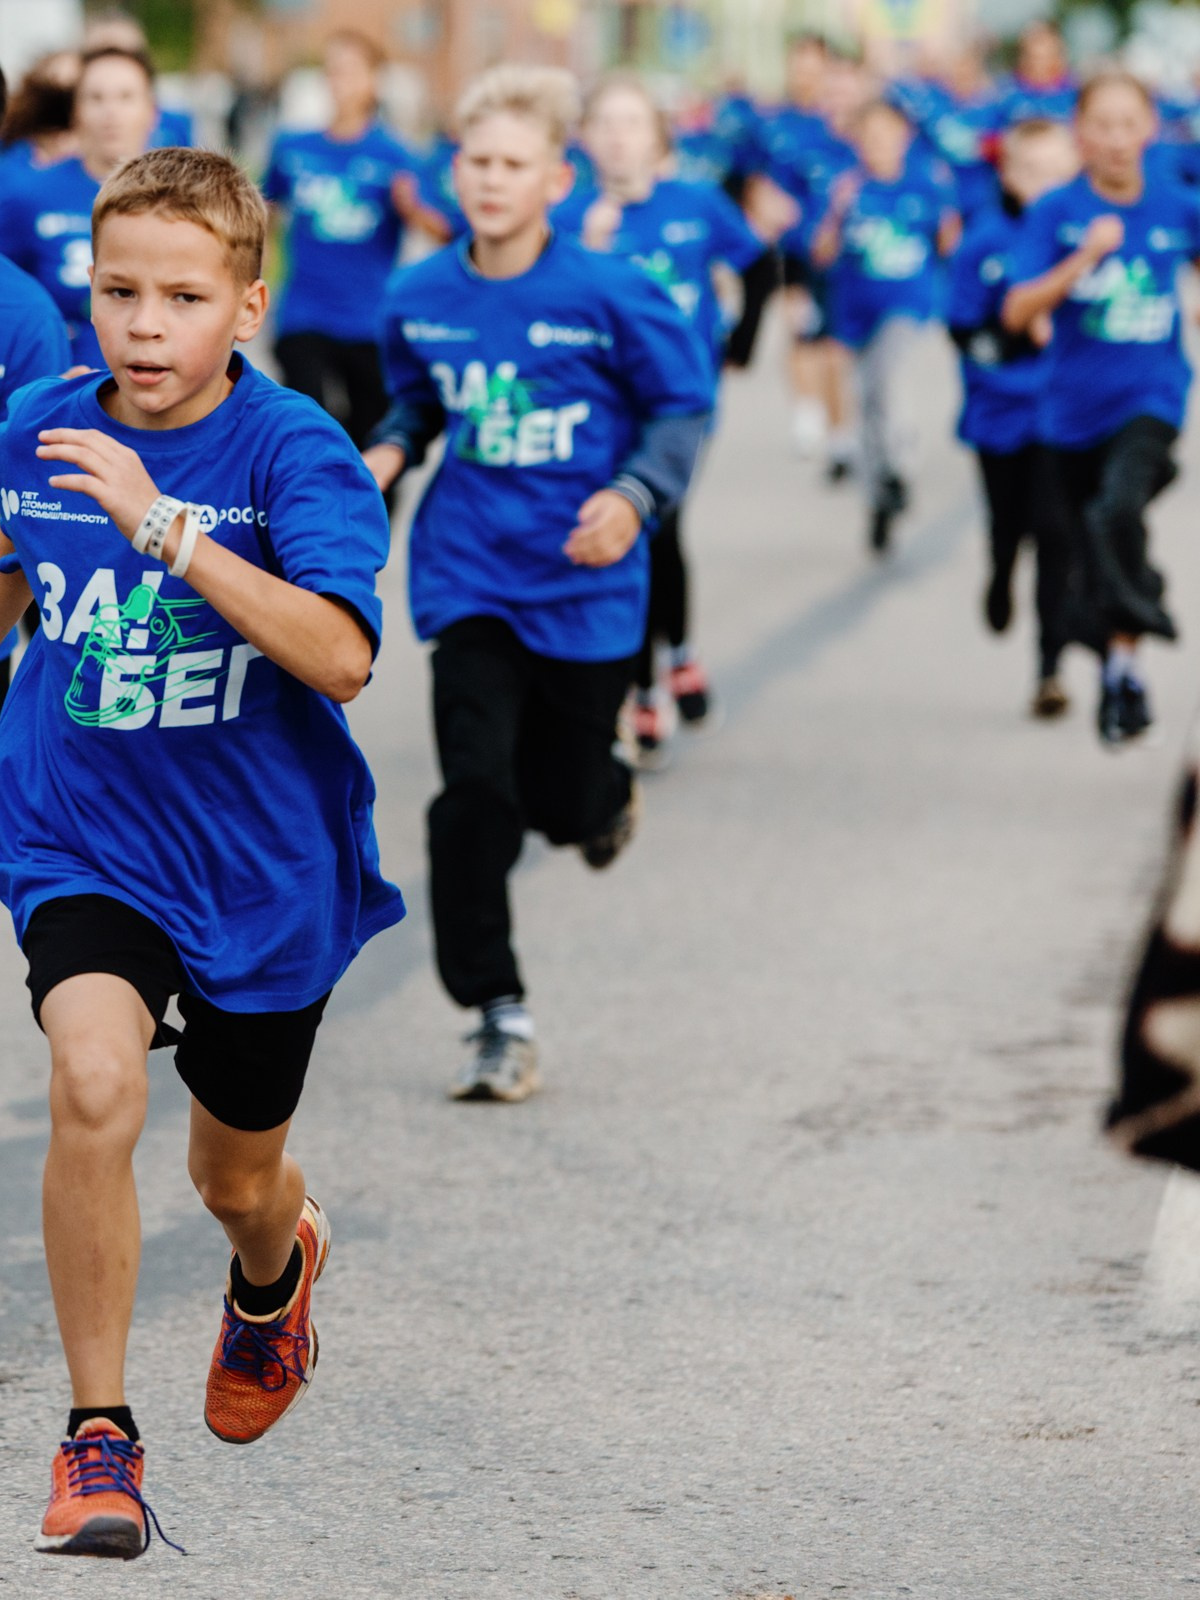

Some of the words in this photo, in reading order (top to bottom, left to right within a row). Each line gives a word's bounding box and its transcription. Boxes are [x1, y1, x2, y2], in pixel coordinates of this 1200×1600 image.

[478, 400, 591, 467] БЕГ
[21, 490, 39, 500] ЛЕТ
[21, 500, 62, 511] АТОМНОЙ
[21, 508, 109, 525] ПРОМЫШЛЕННОСТИ
[36, 561, 165, 650] ЗА!
[98, 643, 267, 731] БЕГ
